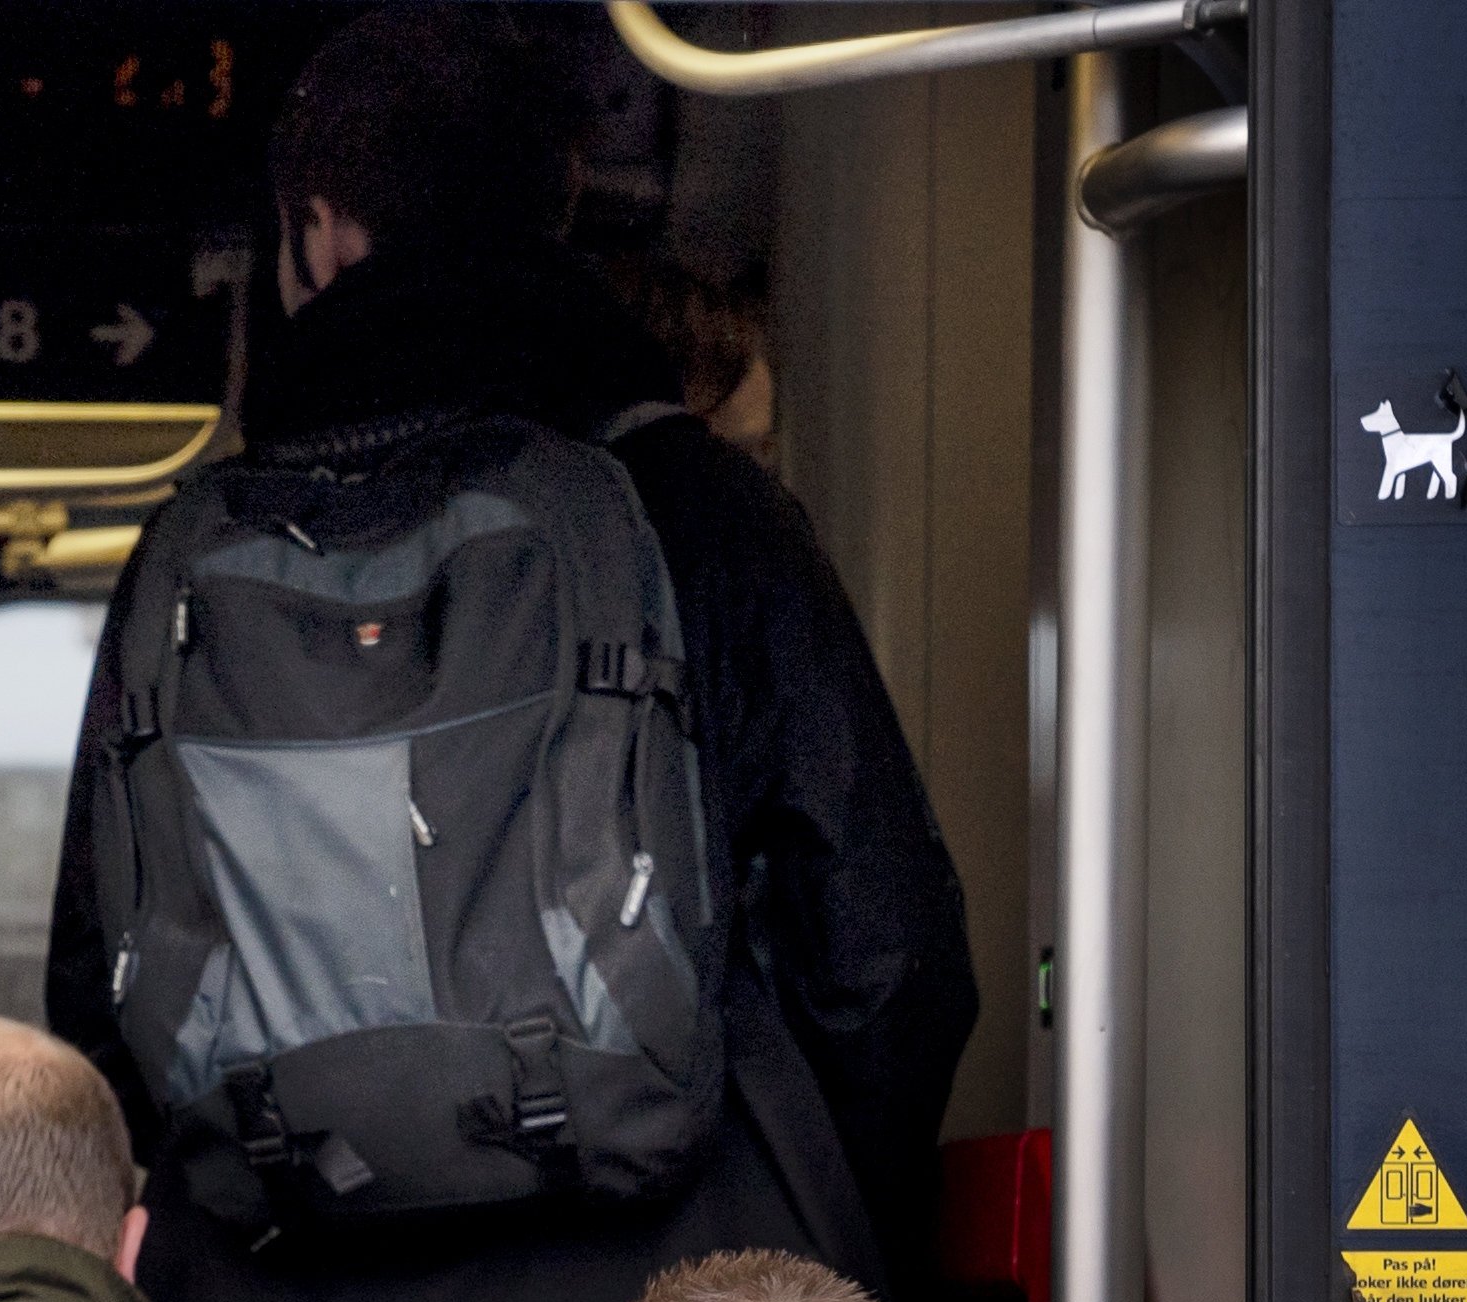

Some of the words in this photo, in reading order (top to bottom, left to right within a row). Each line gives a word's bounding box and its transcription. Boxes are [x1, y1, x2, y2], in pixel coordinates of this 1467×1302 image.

[1384, 1259, 1408, 1270] Pas
[1414, 1259, 1435, 1273] på!
[1358, 1276, 1391, 1288] oker
[1397, 1276, 1427, 1288] ikke
